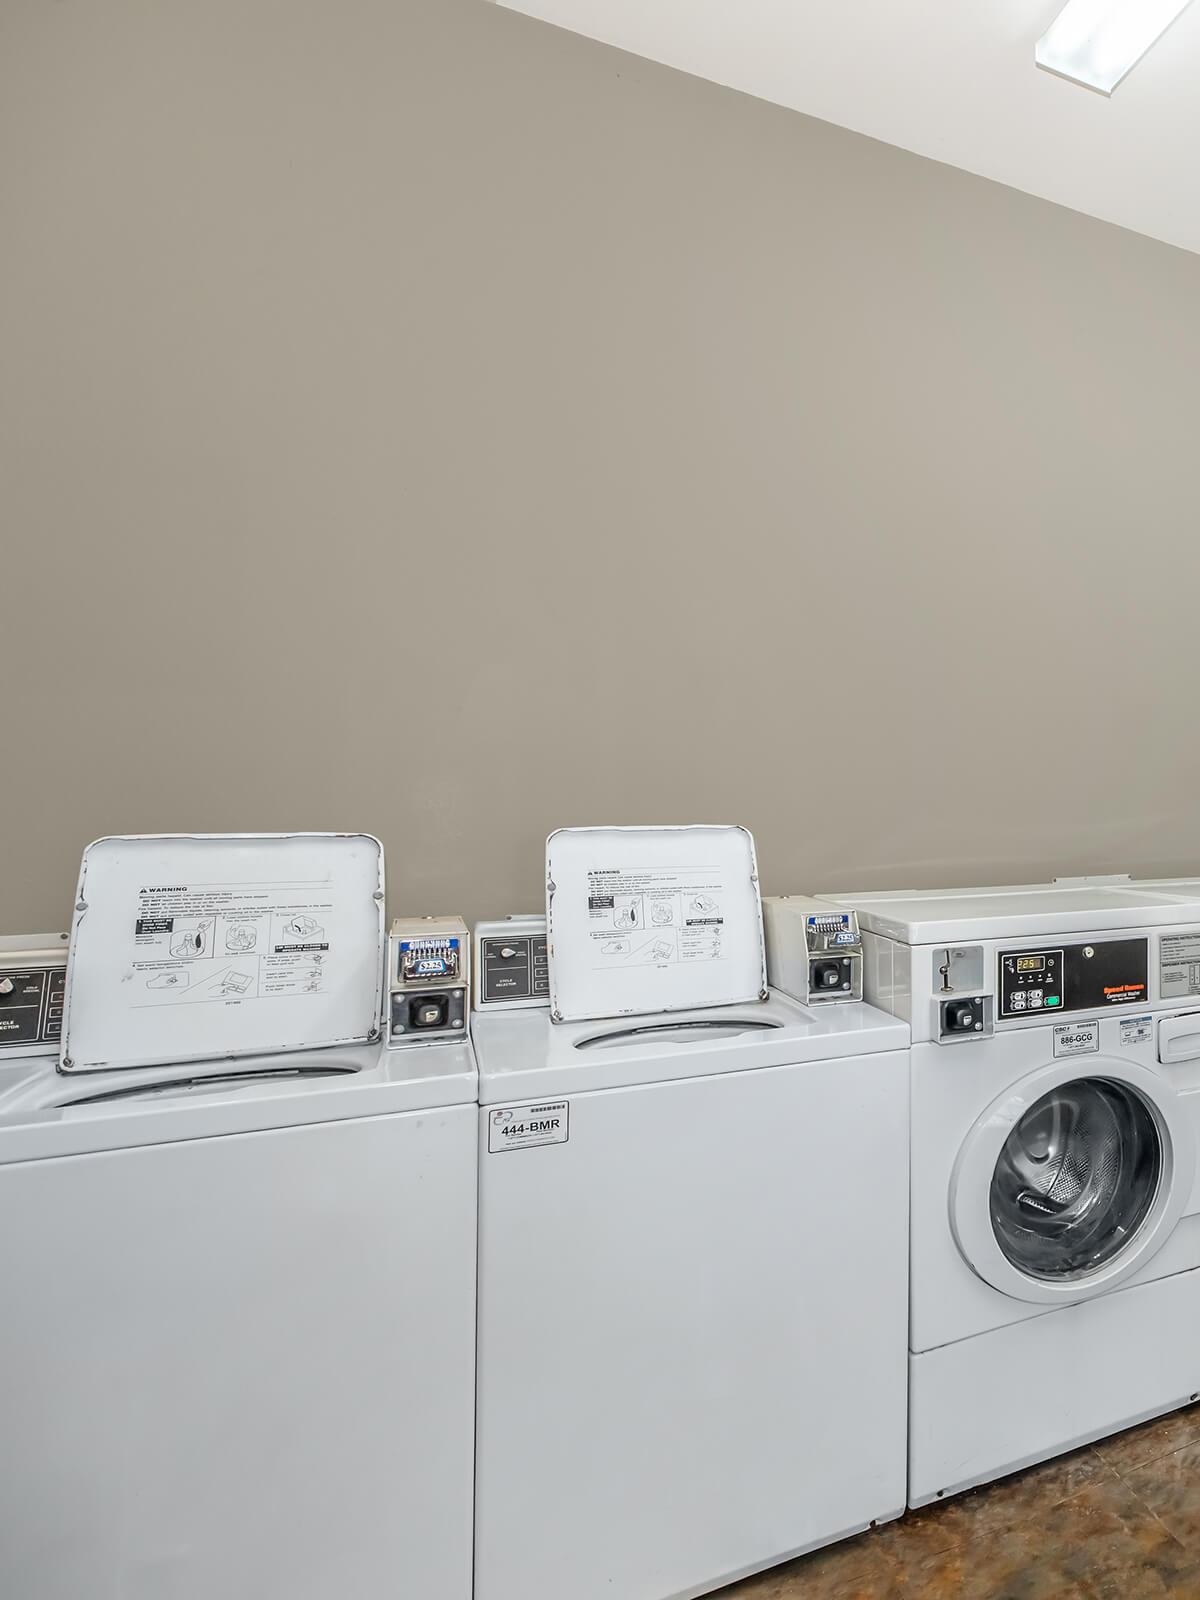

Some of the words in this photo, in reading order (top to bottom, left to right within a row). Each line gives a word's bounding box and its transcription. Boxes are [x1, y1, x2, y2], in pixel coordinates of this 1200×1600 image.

[420, 961, 442, 970] $2.25
[1060, 1033, 1093, 1045] 886-GCG
[501, 1119, 561, 1136] 444-BMR
